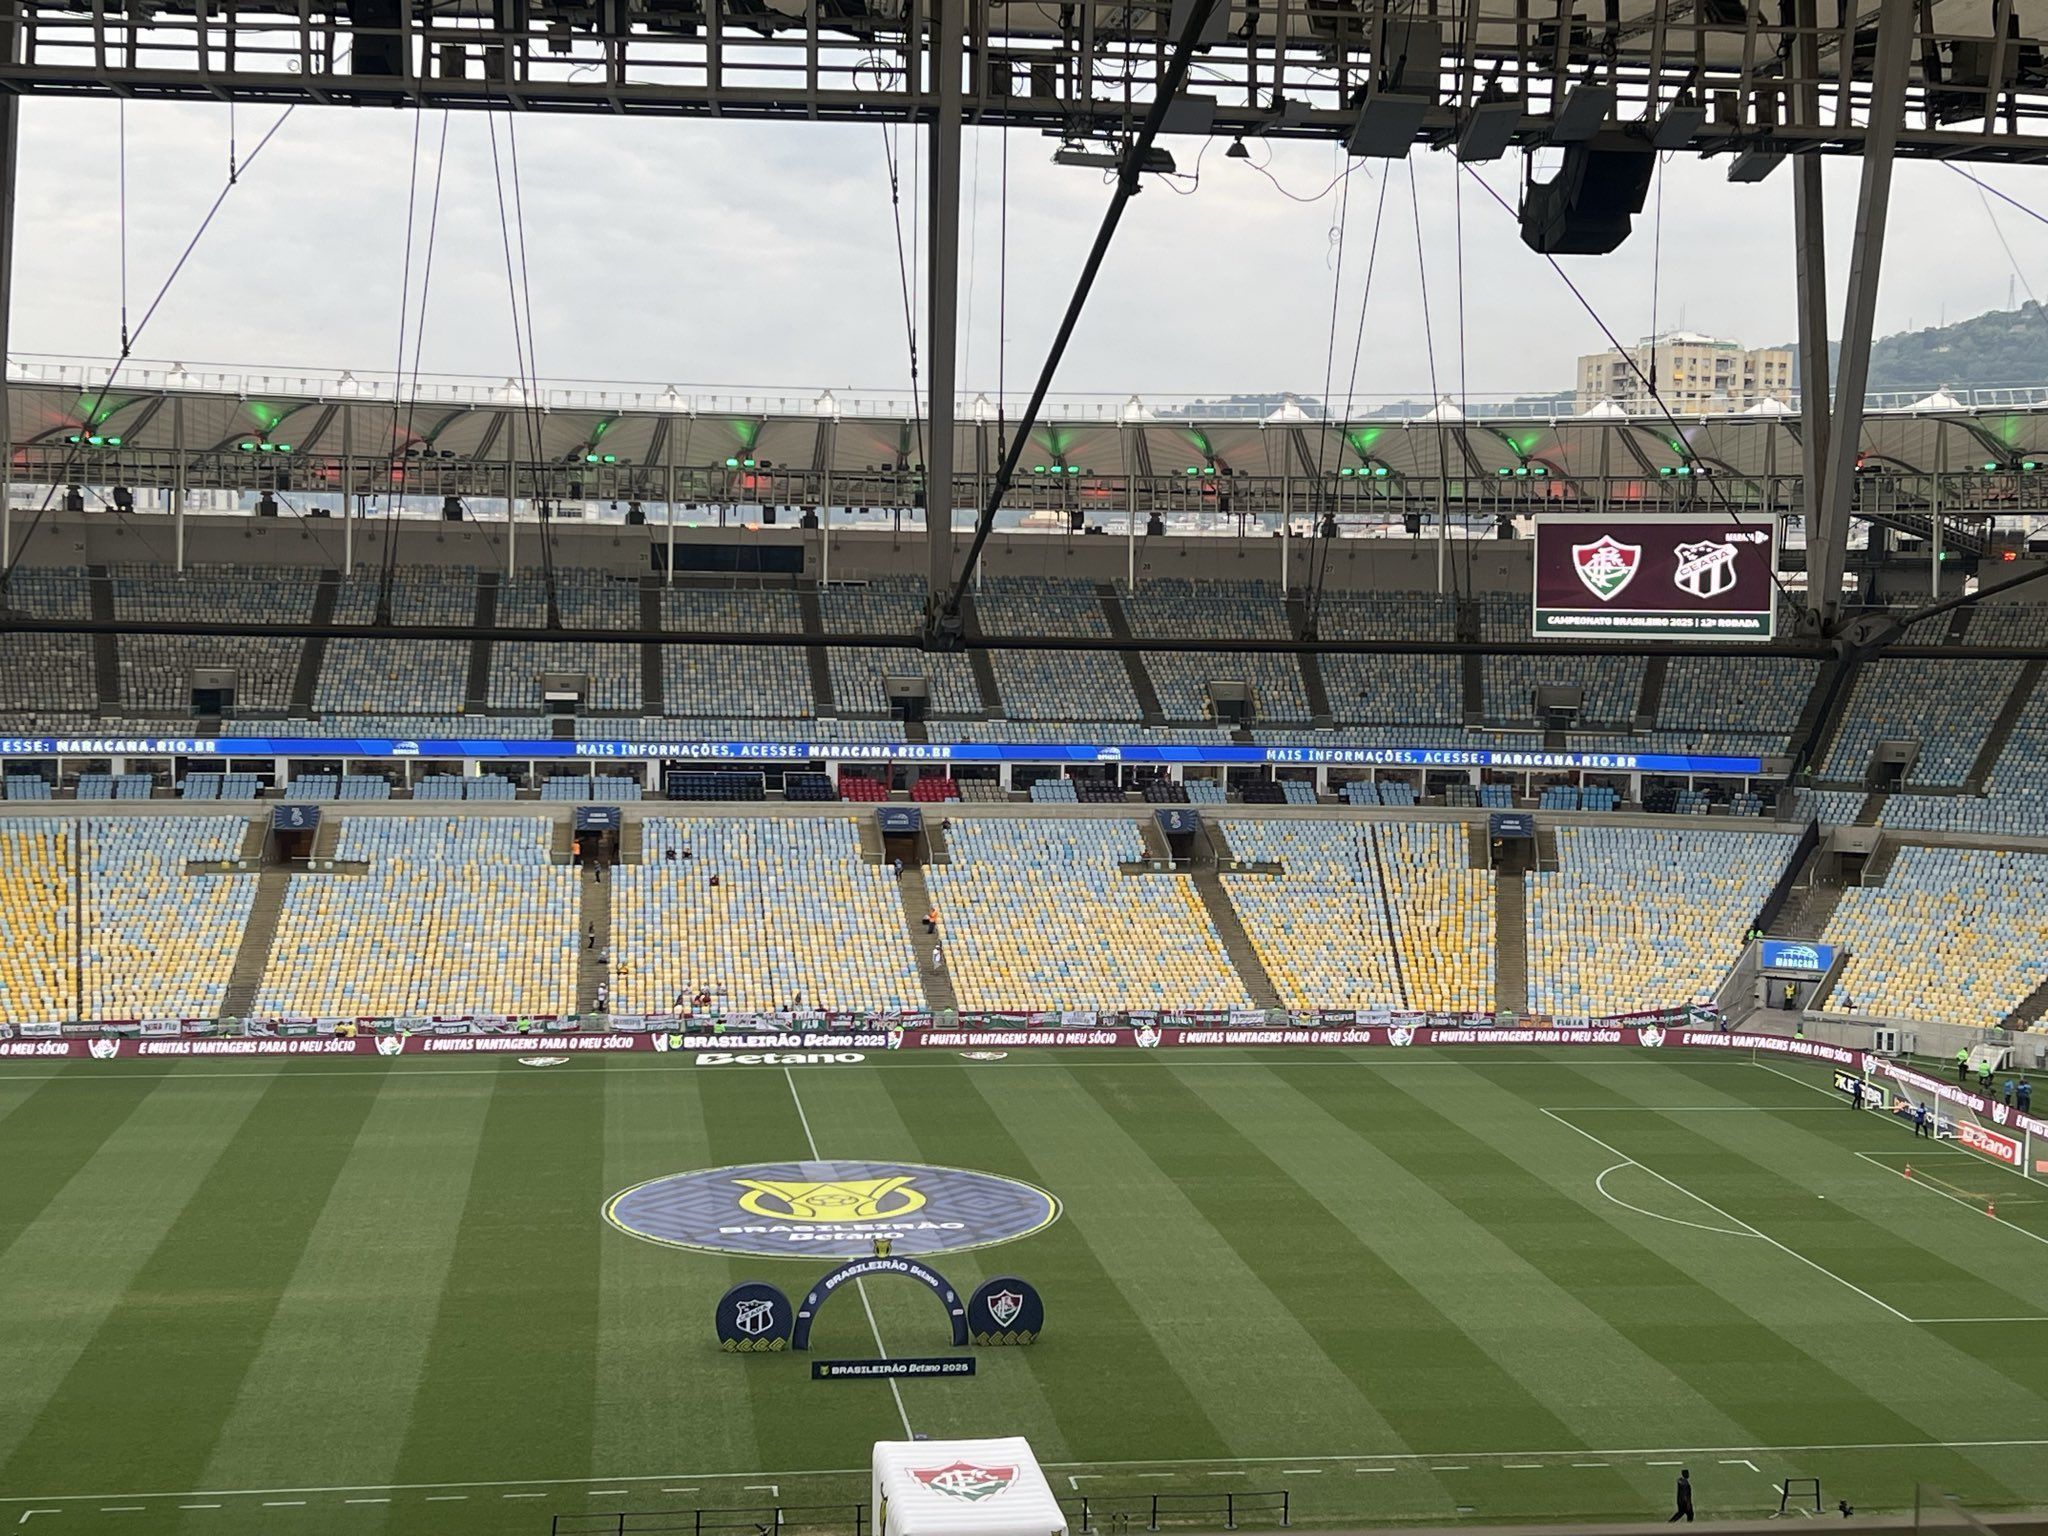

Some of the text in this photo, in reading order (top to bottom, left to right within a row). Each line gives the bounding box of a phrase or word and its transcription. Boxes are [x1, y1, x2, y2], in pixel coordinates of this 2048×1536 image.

[1547, 615, 1612, 626] CAMPEONATO
[1613, 616, 1669, 627] BRASILEIRO
[1669, 618, 1693, 627] 2025
[1718, 619, 1760, 628] RODADA
[56, 740, 216, 752] MARACANA.RIO.BR
[575, 741, 951, 759] MAIS INFORMAÇÕES, ACESSE: MARACANA.RIO.BR
[1265, 747, 1638, 768] MAIS INFORMAÇÕES, ACESSE: MARACANA.RIO.BR
[424, 1034, 634, 1050] E MUITAS VANTAGENS PARA O MEU SÓCIO
[683, 1033, 886, 1049] BRASILEIRÃO Betano 2025
[920, 1030, 1117, 1045] E MUITAS VANTAGENS PARA O MEU SÓCIO
[1178, 1028, 1371, 1043] E MUITAS VANTAGENS PARA O MEU SÓCIO
[1430, 1028, 1620, 1042] E MUITAS VANTAGENS PARA O MEU SÓCIO
[10, 1043, 35, 1054] MEU
[37, 1040, 69, 1055] SÓCIO
[138, 1037, 356, 1054] E MUITAS VANTAGENS PARA O MEU SÓCIO
[1683, 1033, 1853, 1063] E MUITAS VANTAGENS PARA O MEU SÓCIO
[695, 1052, 866, 1065] Betano
[1962, 1126, 2013, 1159] Betano
[718, 1221, 965, 1234] BRASILEIRÃO
[788, 1231, 905, 1241] Betano
[825, 1259, 939, 1289] BRASILEIRÃO Betano
[831, 1362, 968, 1375] BRASILEIRÃO Betano 2025
